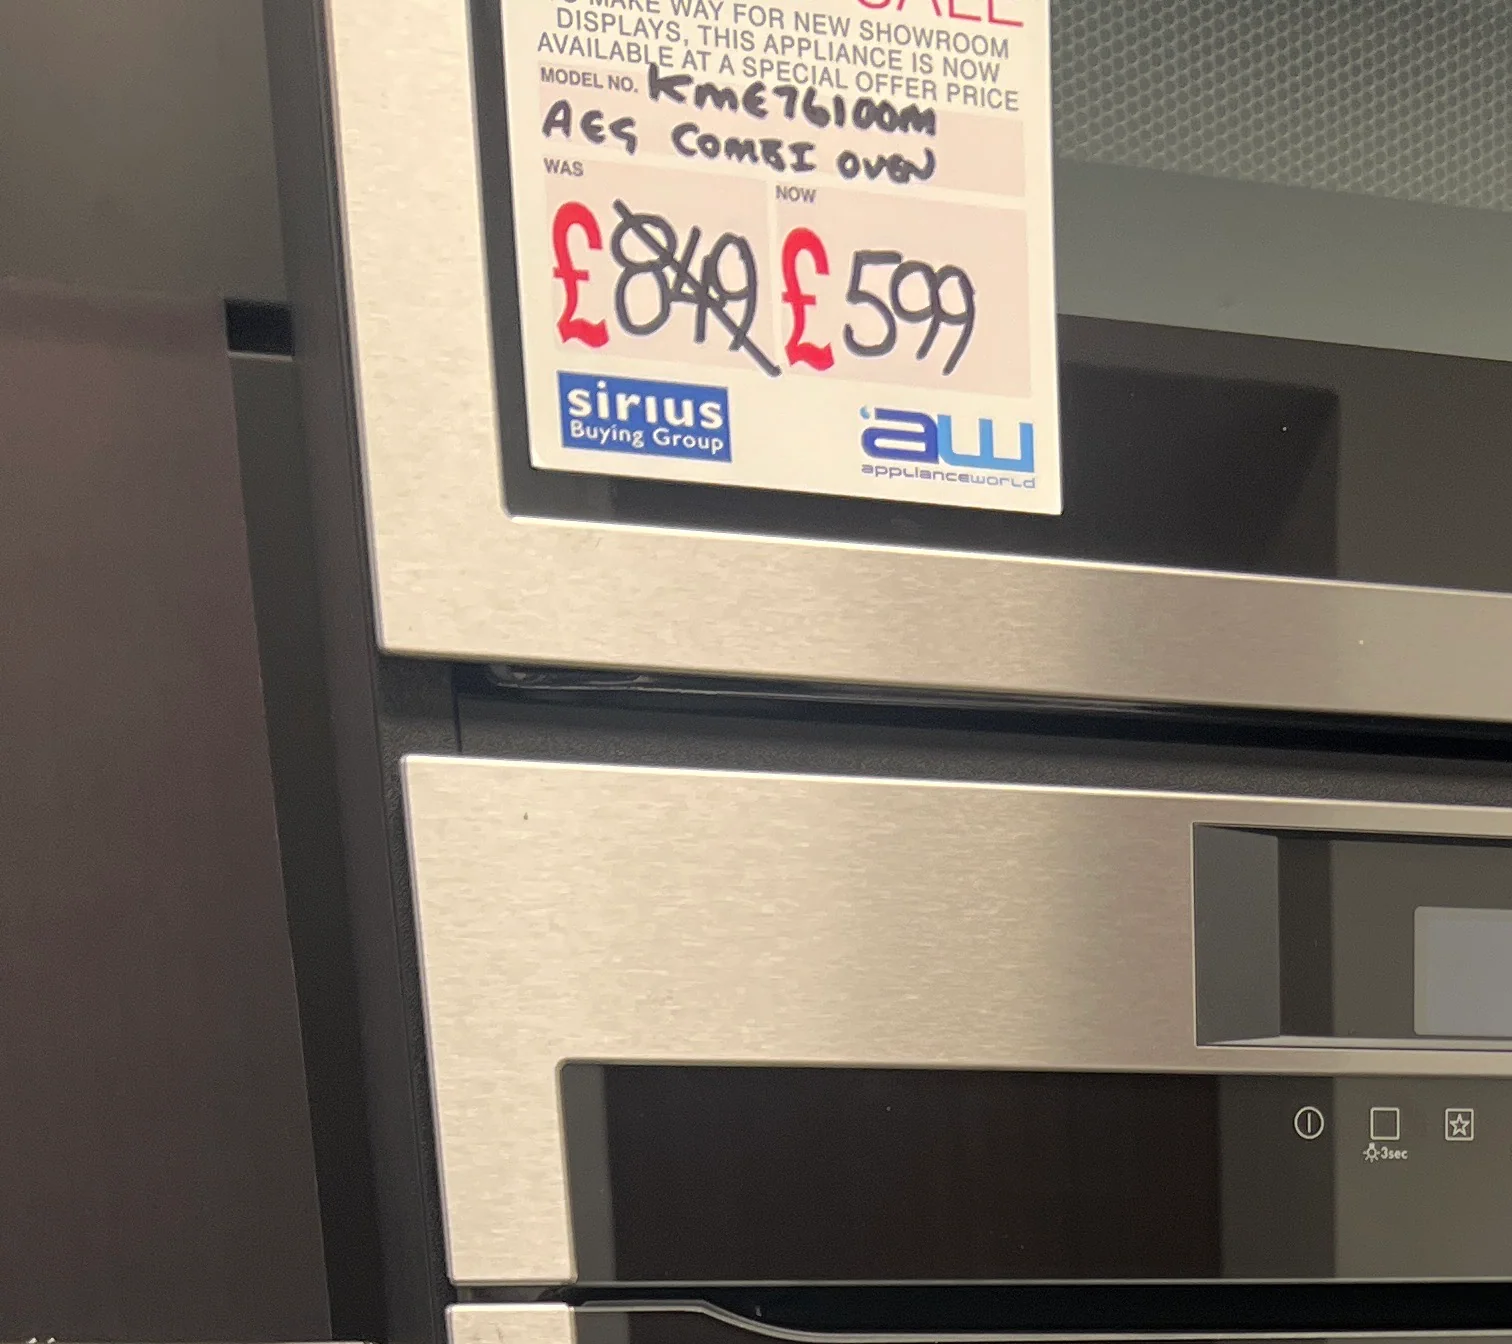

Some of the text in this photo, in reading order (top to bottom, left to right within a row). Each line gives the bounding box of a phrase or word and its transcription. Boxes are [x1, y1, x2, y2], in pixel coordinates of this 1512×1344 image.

[556, 7, 1001, 84] DISPLAYS, THIS APPLIANCE IS NOW
[671, 0, 724, 21] WAY
[733, 3, 785, 30] FOR
[794, 11, 851, 38] NEW
[859, 19, 1009, 60] SHOWROOM
[537, 31, 1020, 112] AVAILABLE AT A SPECIAL OFFER PRICE
[540, 67, 604, 90] MODEL
[607, 74, 639, 94] NO.
[543, 157, 585, 178] WAS
[775, 185, 817, 203] NOW
[567, 381, 725, 430] sirius
[569, 419, 725, 455] Buying Group
[860, 463, 1036, 489] applianceworld
[1380, 1145, 1409, 1162] 3sec
